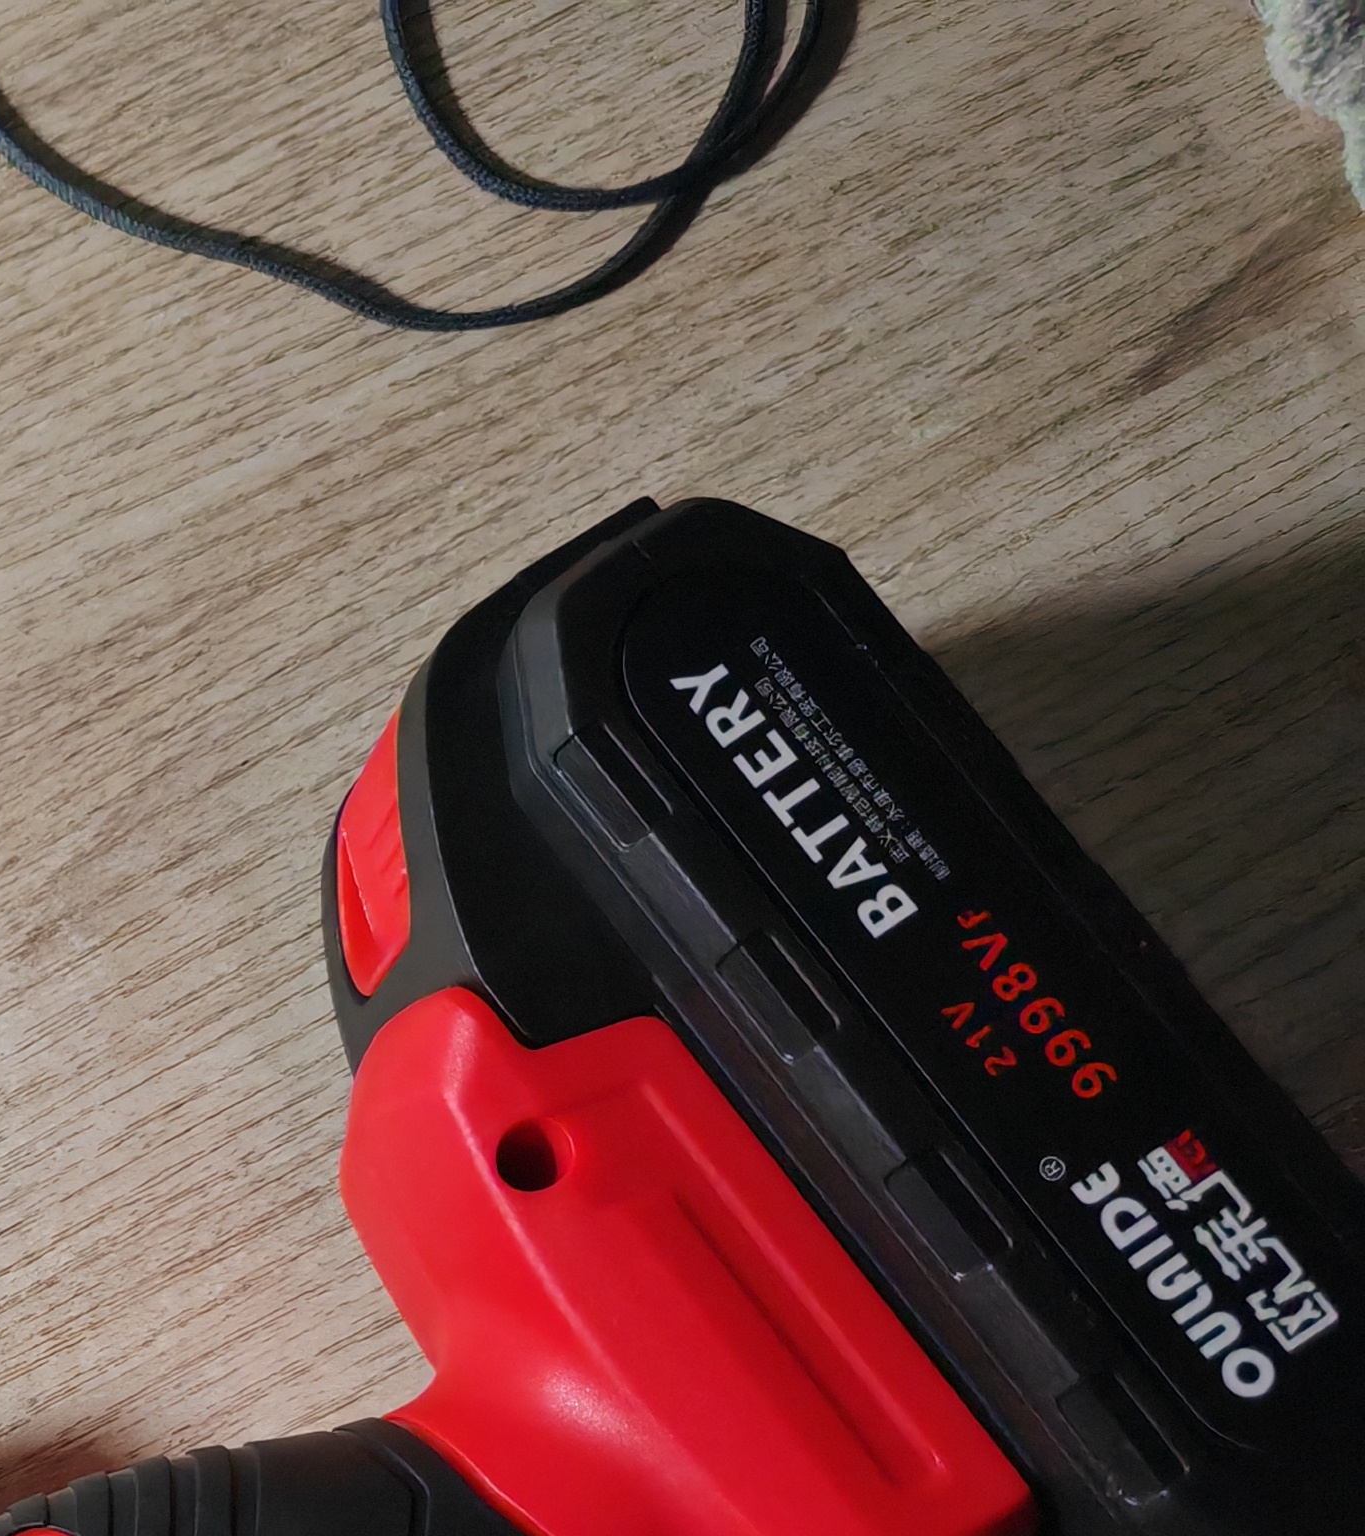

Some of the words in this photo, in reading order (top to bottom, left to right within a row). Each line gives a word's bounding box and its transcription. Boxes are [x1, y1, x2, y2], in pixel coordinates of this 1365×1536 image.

[670, 664, 918, 938] BATTERY
[942, 1002, 1017, 1076] 21V
[1137, 1131, 1338, 1352] 欧莱德
